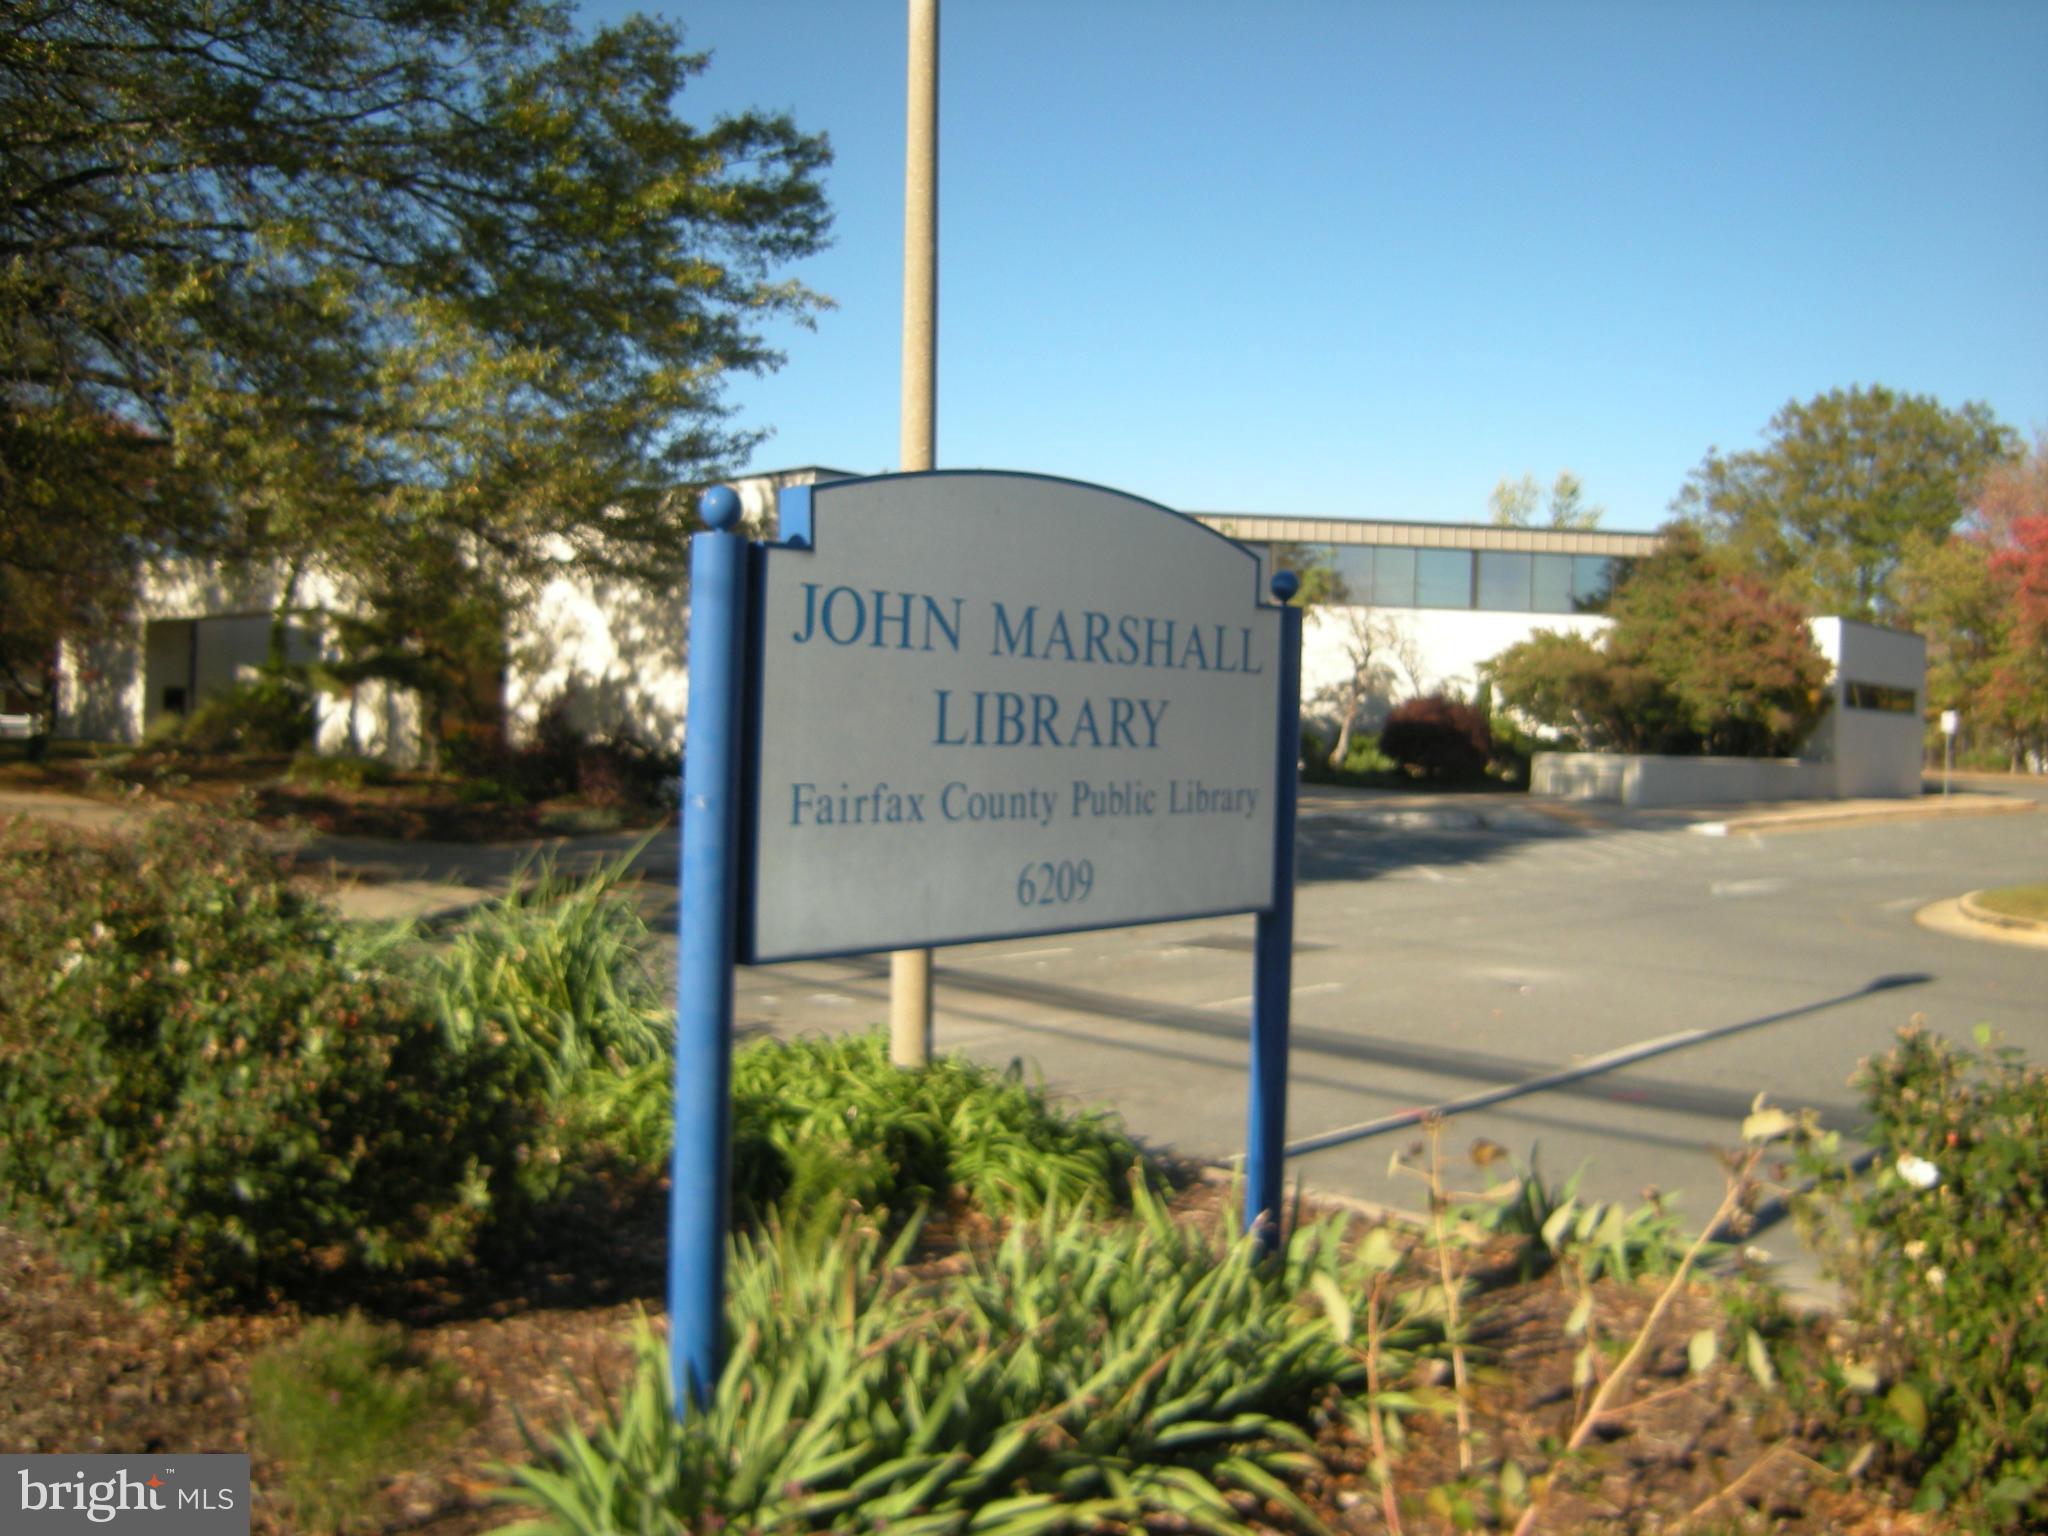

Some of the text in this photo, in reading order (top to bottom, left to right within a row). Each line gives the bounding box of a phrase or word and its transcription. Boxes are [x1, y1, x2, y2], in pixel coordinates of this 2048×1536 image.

[792, 582, 1264, 675] JOHN MARSHALL
[932, 689, 1169, 749] LIBRARY
[789, 778, 1260, 827] Fairfax County Public Library
[1016, 858, 1095, 907] 6209
